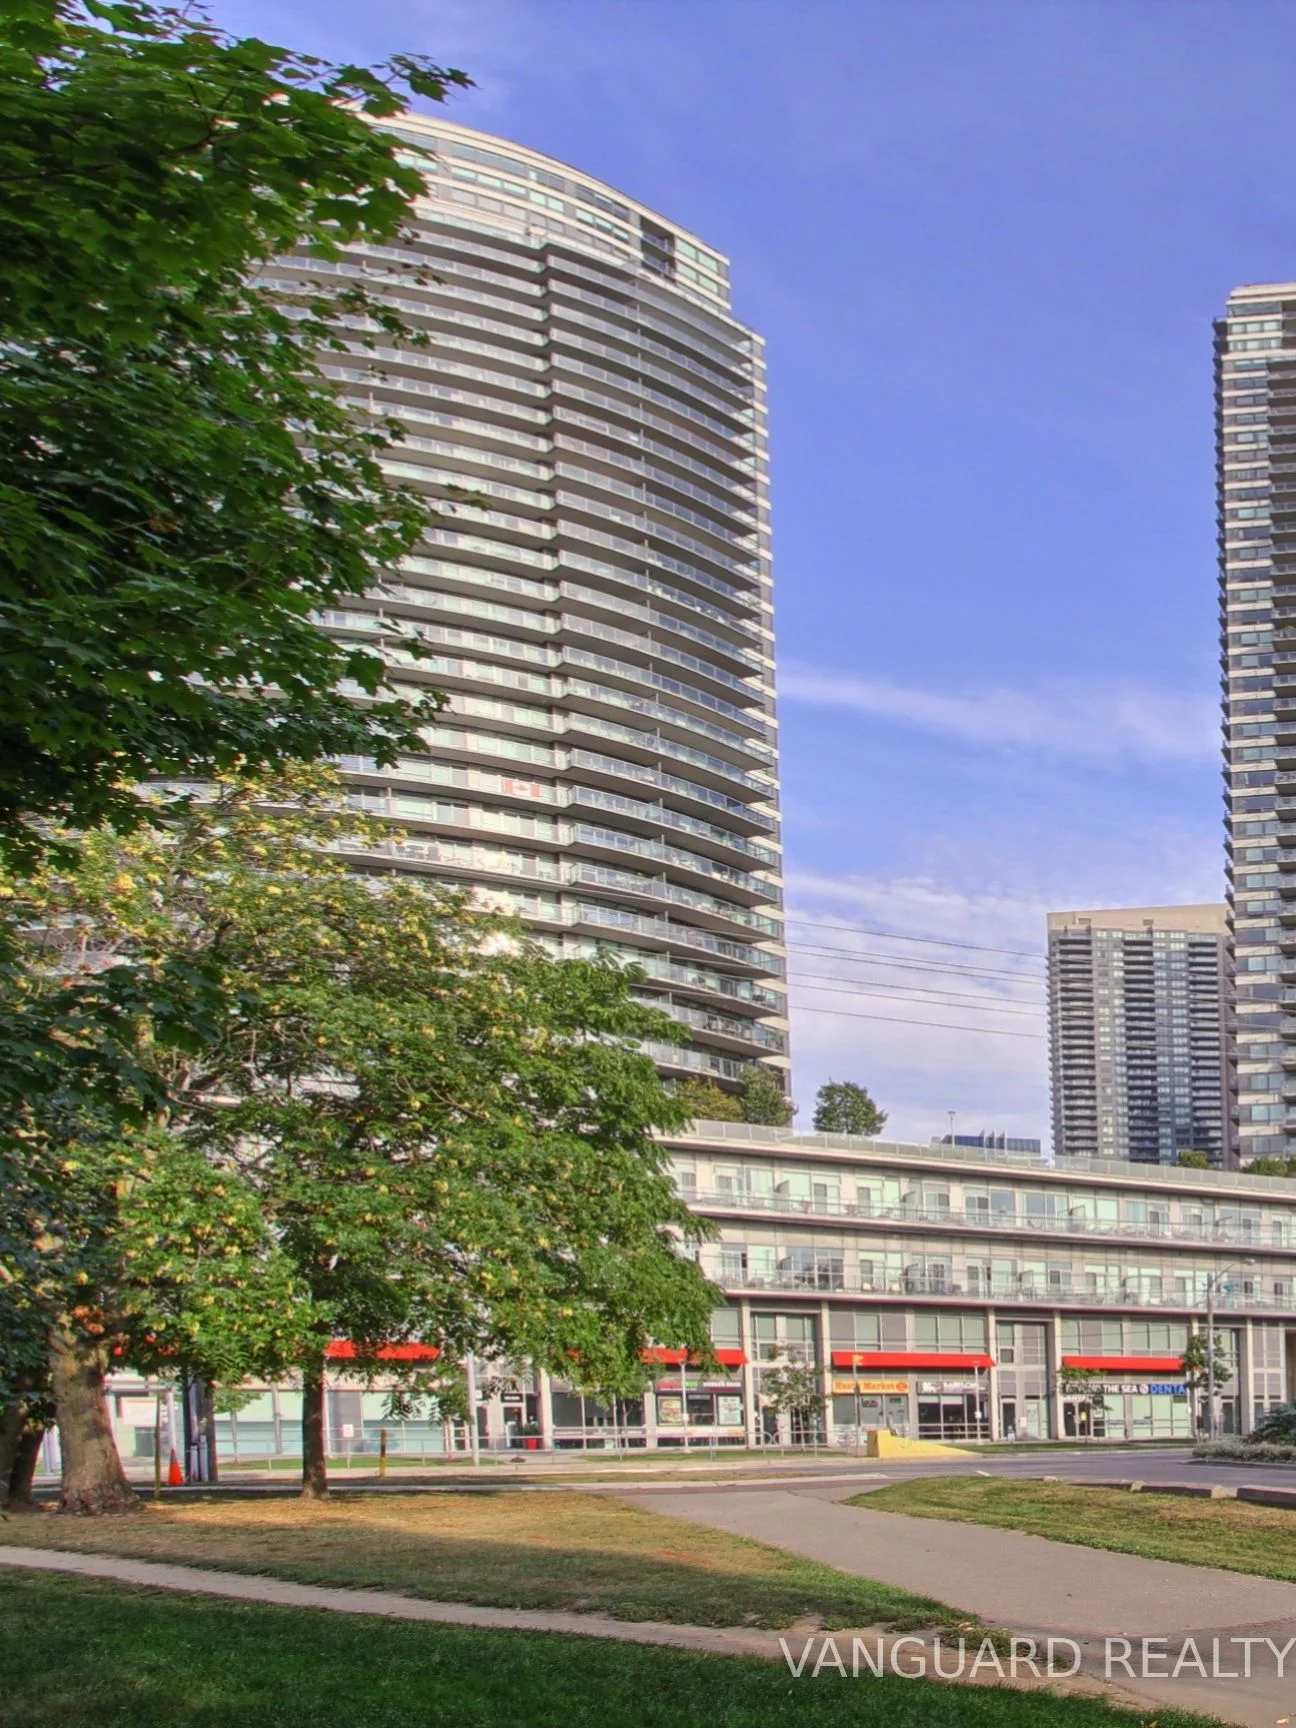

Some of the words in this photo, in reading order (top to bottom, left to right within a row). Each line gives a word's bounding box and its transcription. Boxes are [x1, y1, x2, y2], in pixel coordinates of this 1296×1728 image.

[1103, 1383, 1119, 1393] THE
[1121, 1383, 1138, 1393] SEA
[1150, 1383, 1185, 1393] DENTA
